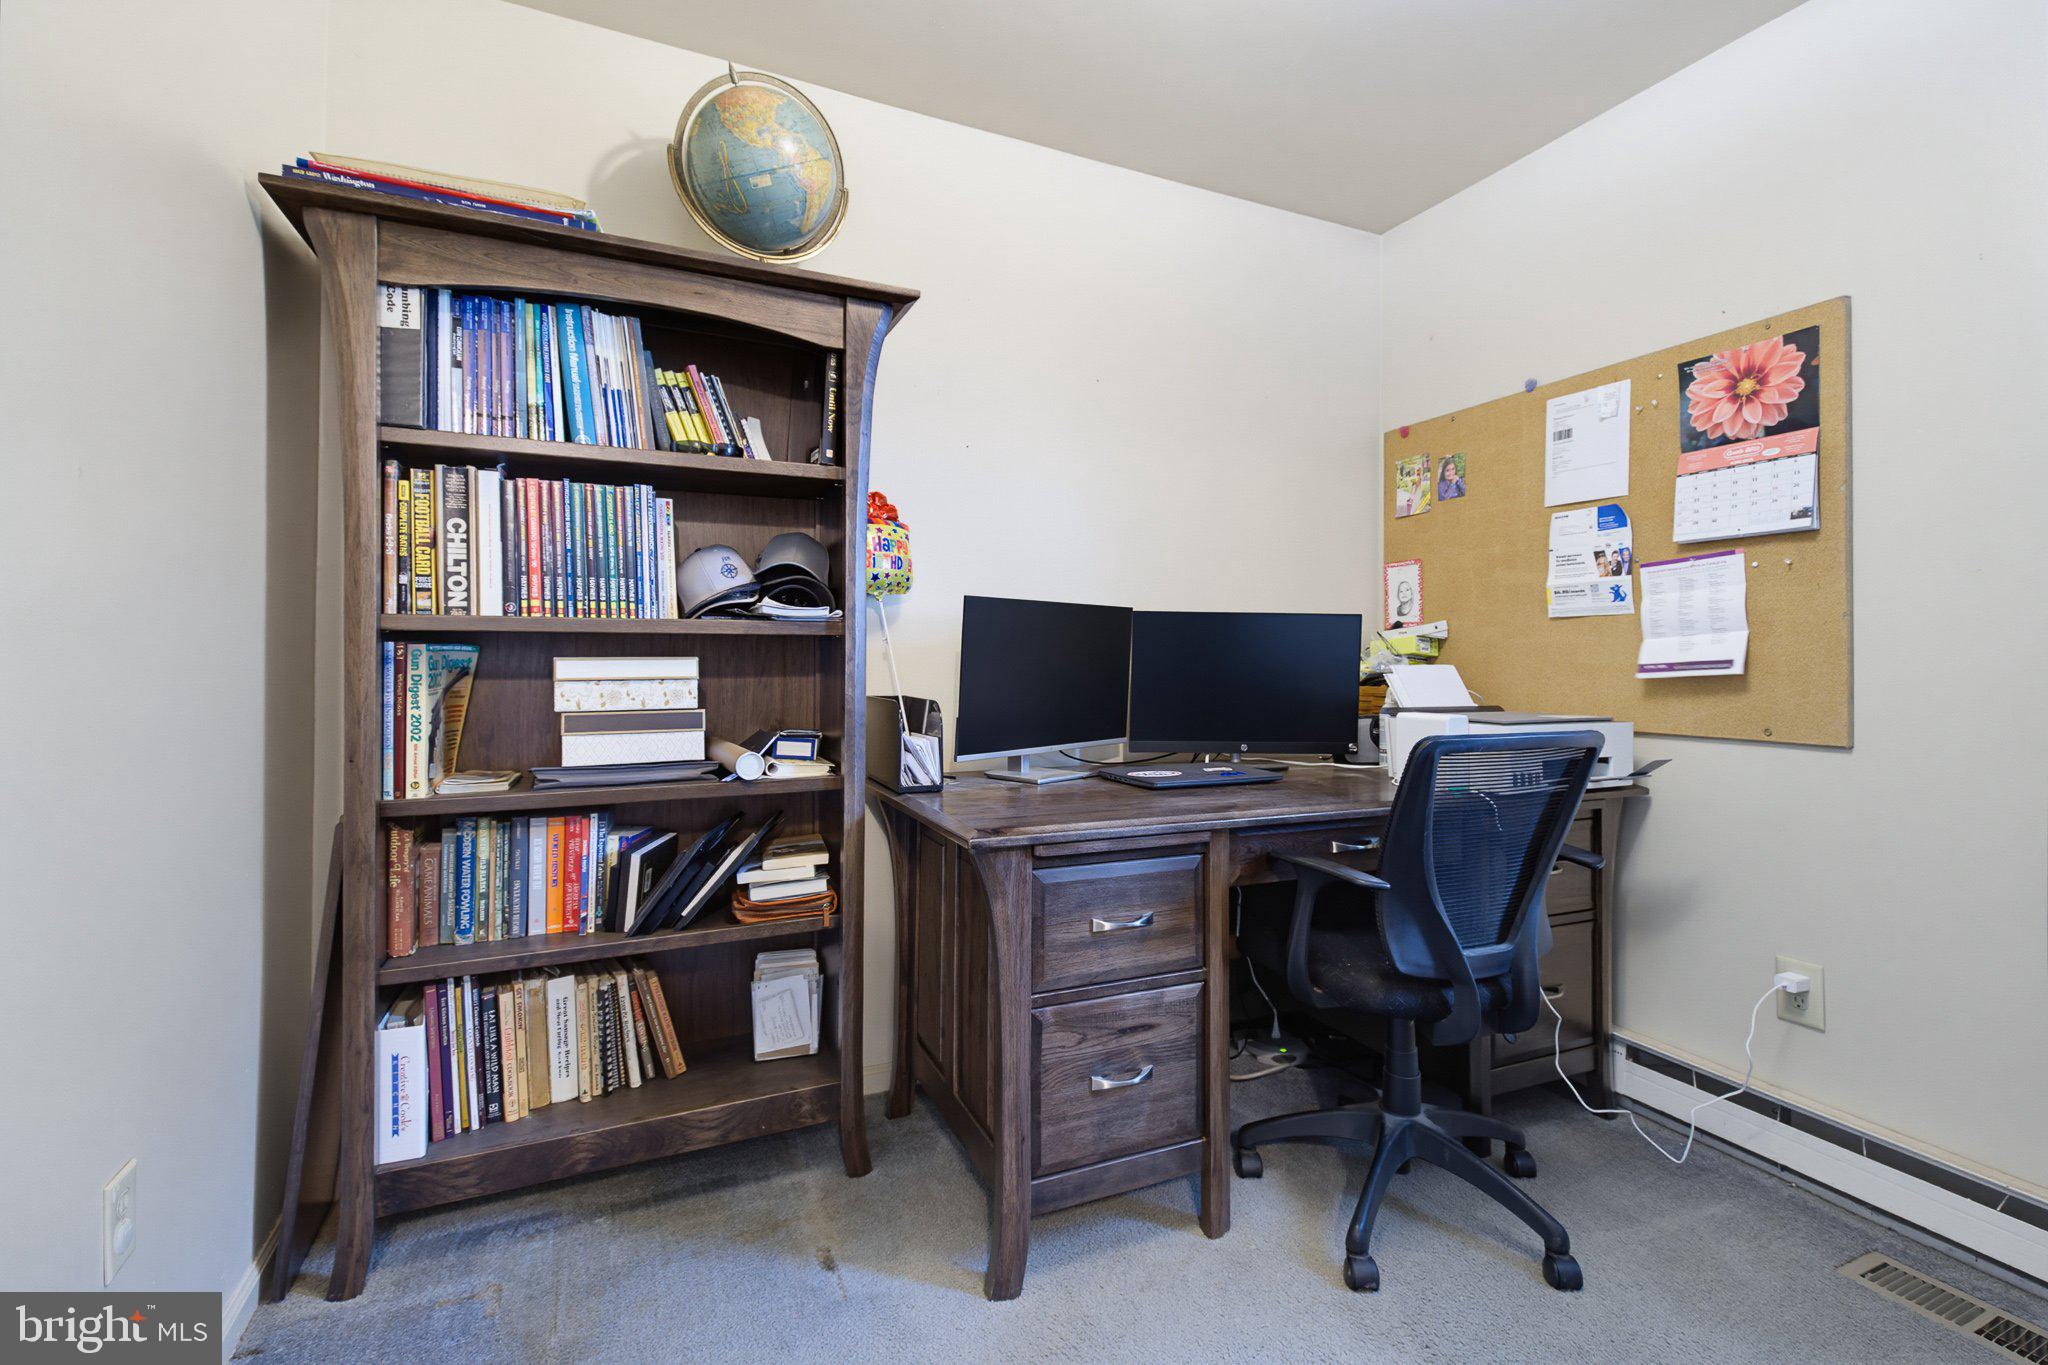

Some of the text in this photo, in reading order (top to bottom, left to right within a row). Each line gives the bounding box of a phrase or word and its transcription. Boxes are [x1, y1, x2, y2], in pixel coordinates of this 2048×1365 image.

[565, 308, 577, 353] Instruction
[569, 353, 581, 383] Manual
[827, 387, 837, 433] Until Now
[399, 502, 408, 533] COMPLETE
[415, 493, 432, 575] FOOTBALL CARD
[399, 535, 408, 556] BATHS
[447, 518, 467, 607] CHILTON
[408, 649, 422, 743] Gun Digest 2002
[390, 864, 401, 888] Life
[424, 858, 434, 925] GAME ANIMALS
[400, 1056, 410, 1093] Creative
[490, 1052, 498, 1071] WILD
[506, 1062, 514, 1097] COOKBOOK
